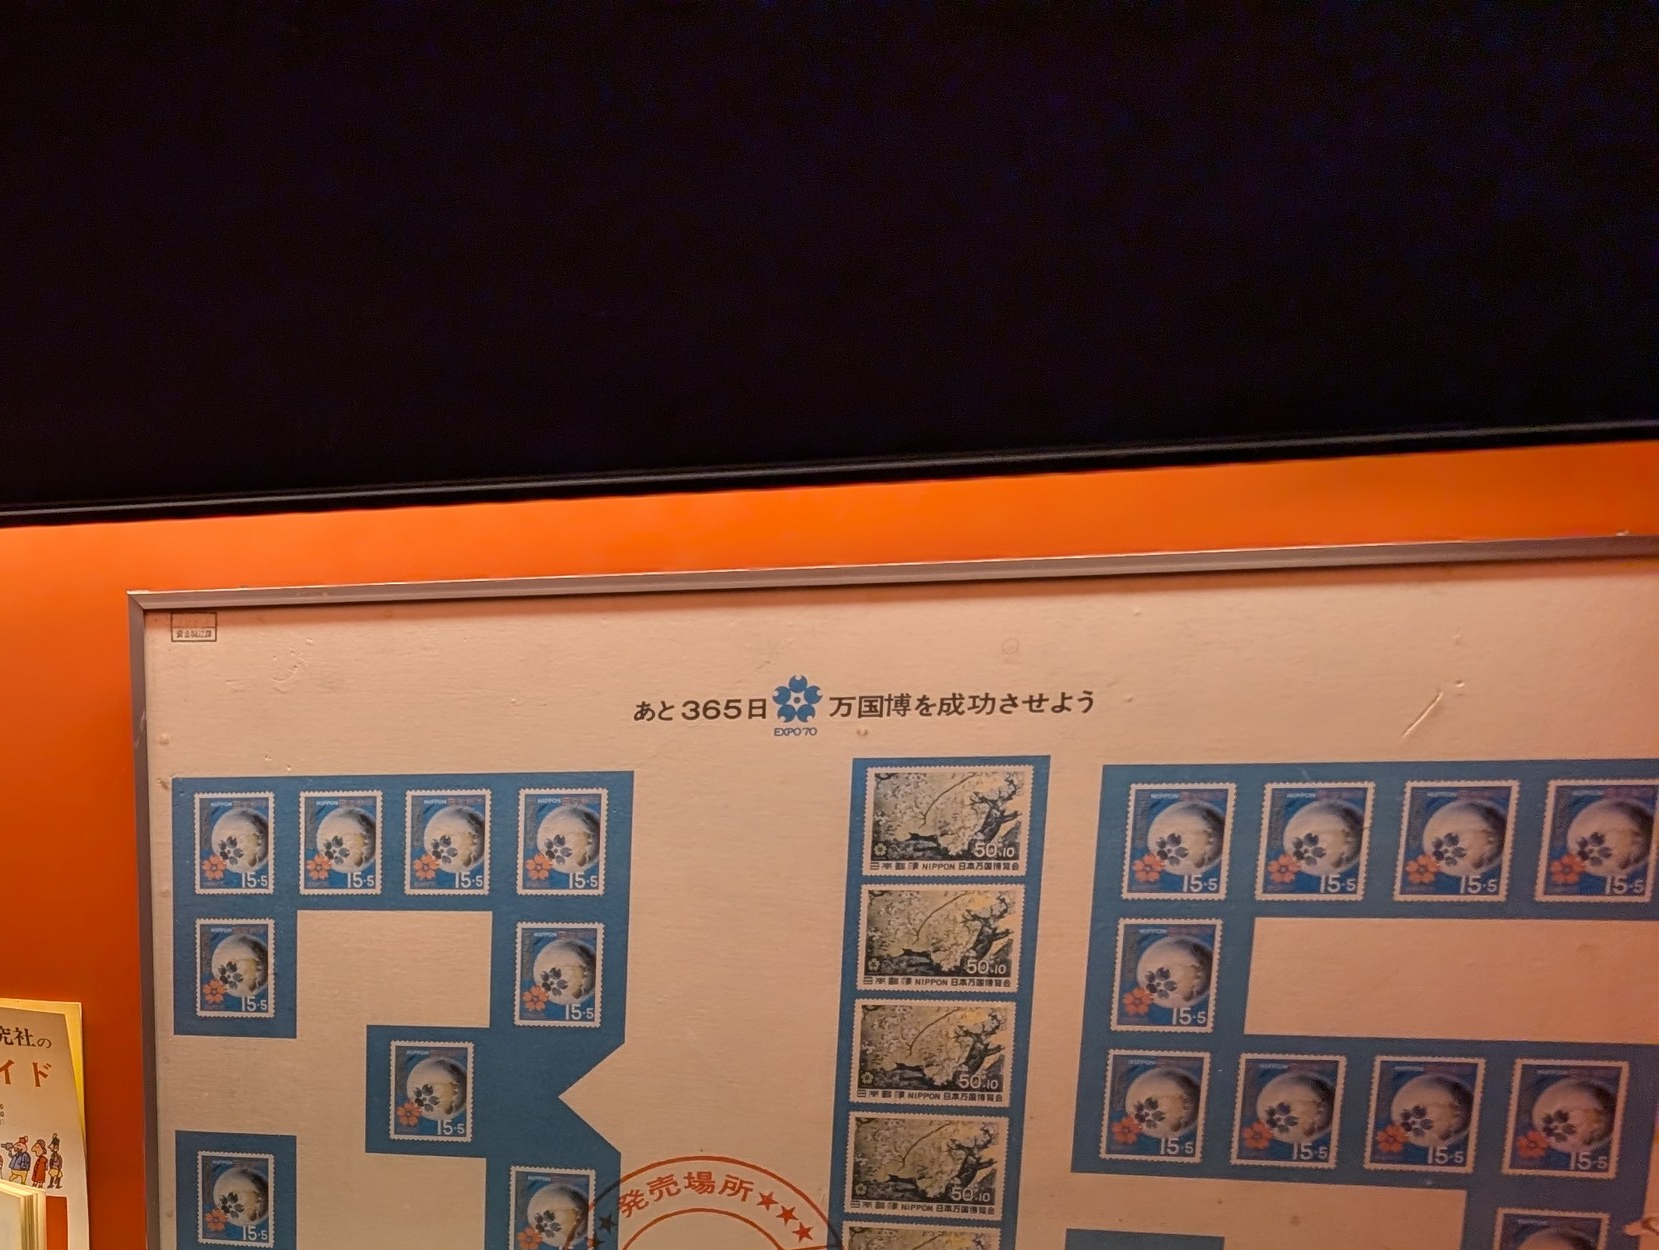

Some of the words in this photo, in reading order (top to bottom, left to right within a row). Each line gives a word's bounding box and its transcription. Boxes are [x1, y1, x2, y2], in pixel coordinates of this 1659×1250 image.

[633, 698, 768, 722] あと365日
[828, 689, 1097, 720] 万国博を成功させよう
[617, 1170, 755, 1218] 発売場所
